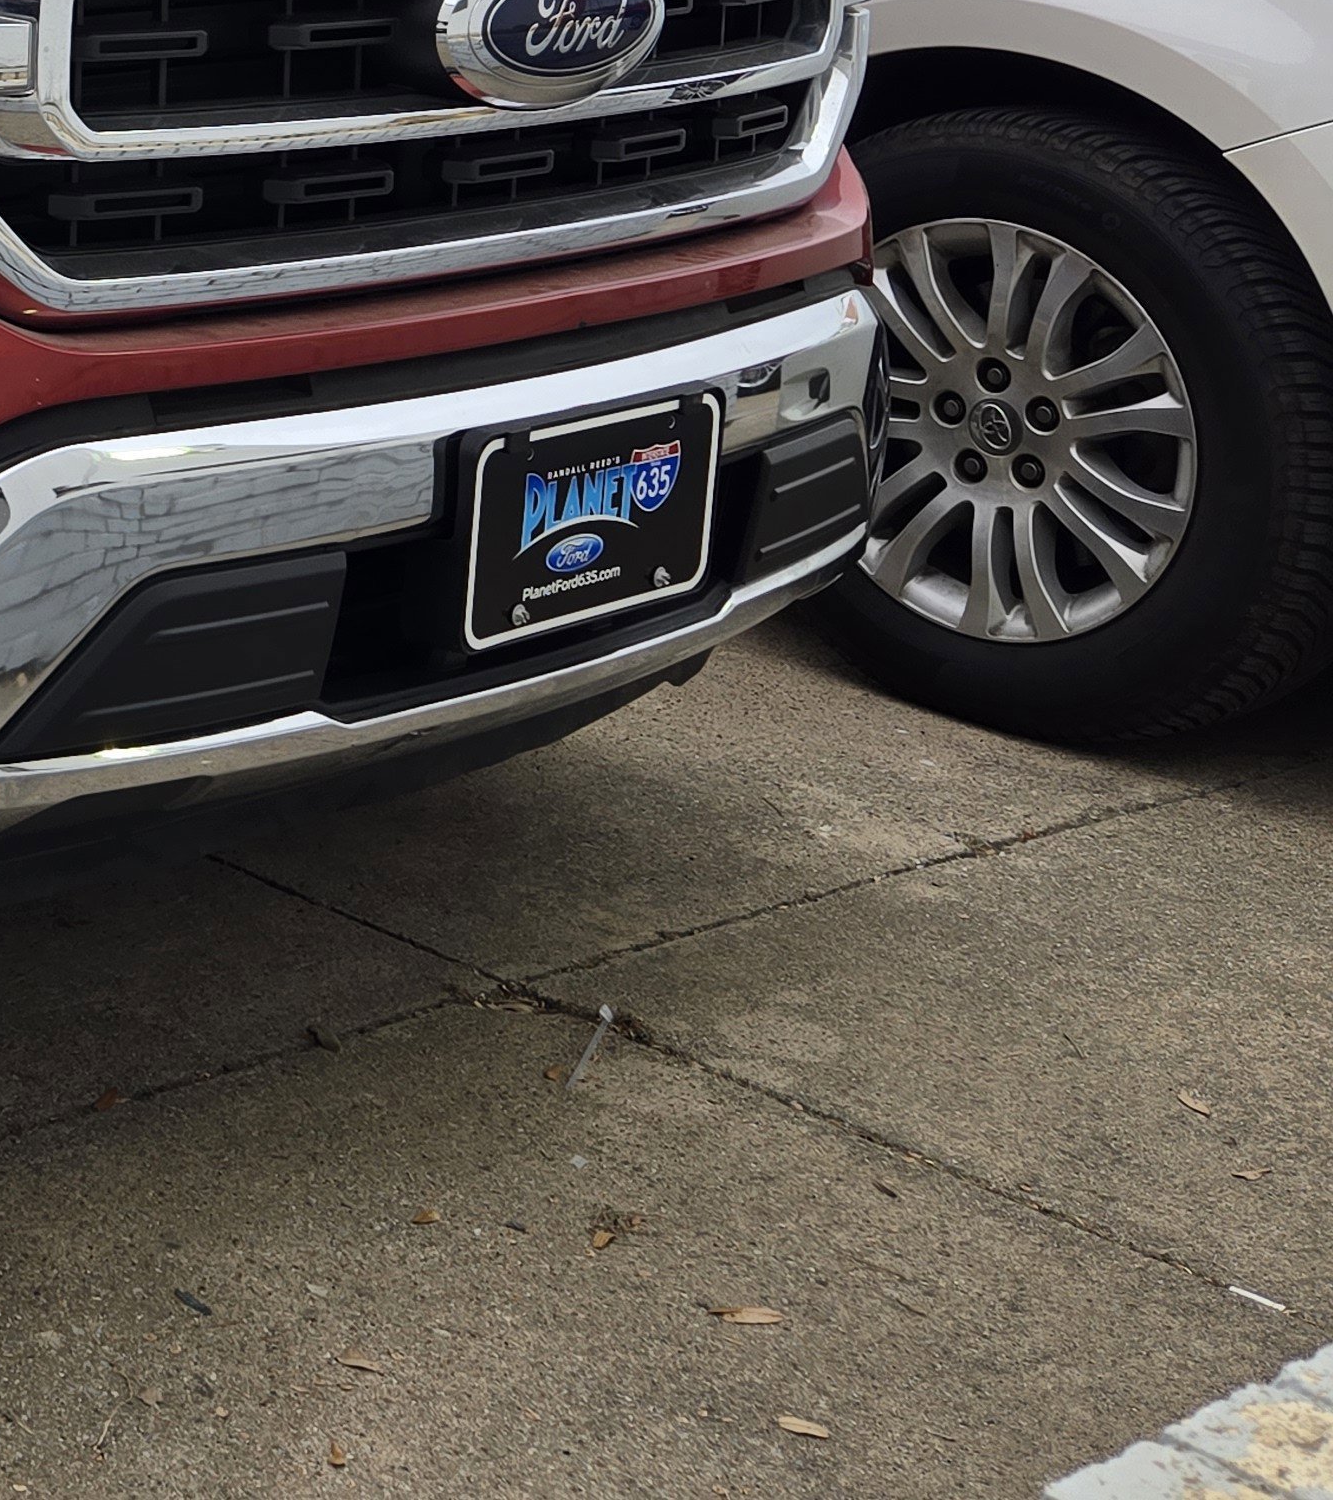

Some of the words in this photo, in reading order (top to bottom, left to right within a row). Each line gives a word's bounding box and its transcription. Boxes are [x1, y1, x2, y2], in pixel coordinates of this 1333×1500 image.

[520, 462, 638, 551] PLANET
[636, 464, 672, 501] 635
[556, 540, 594, 567] Ford
[522, 565, 622, 601] PlanetFord635.com
